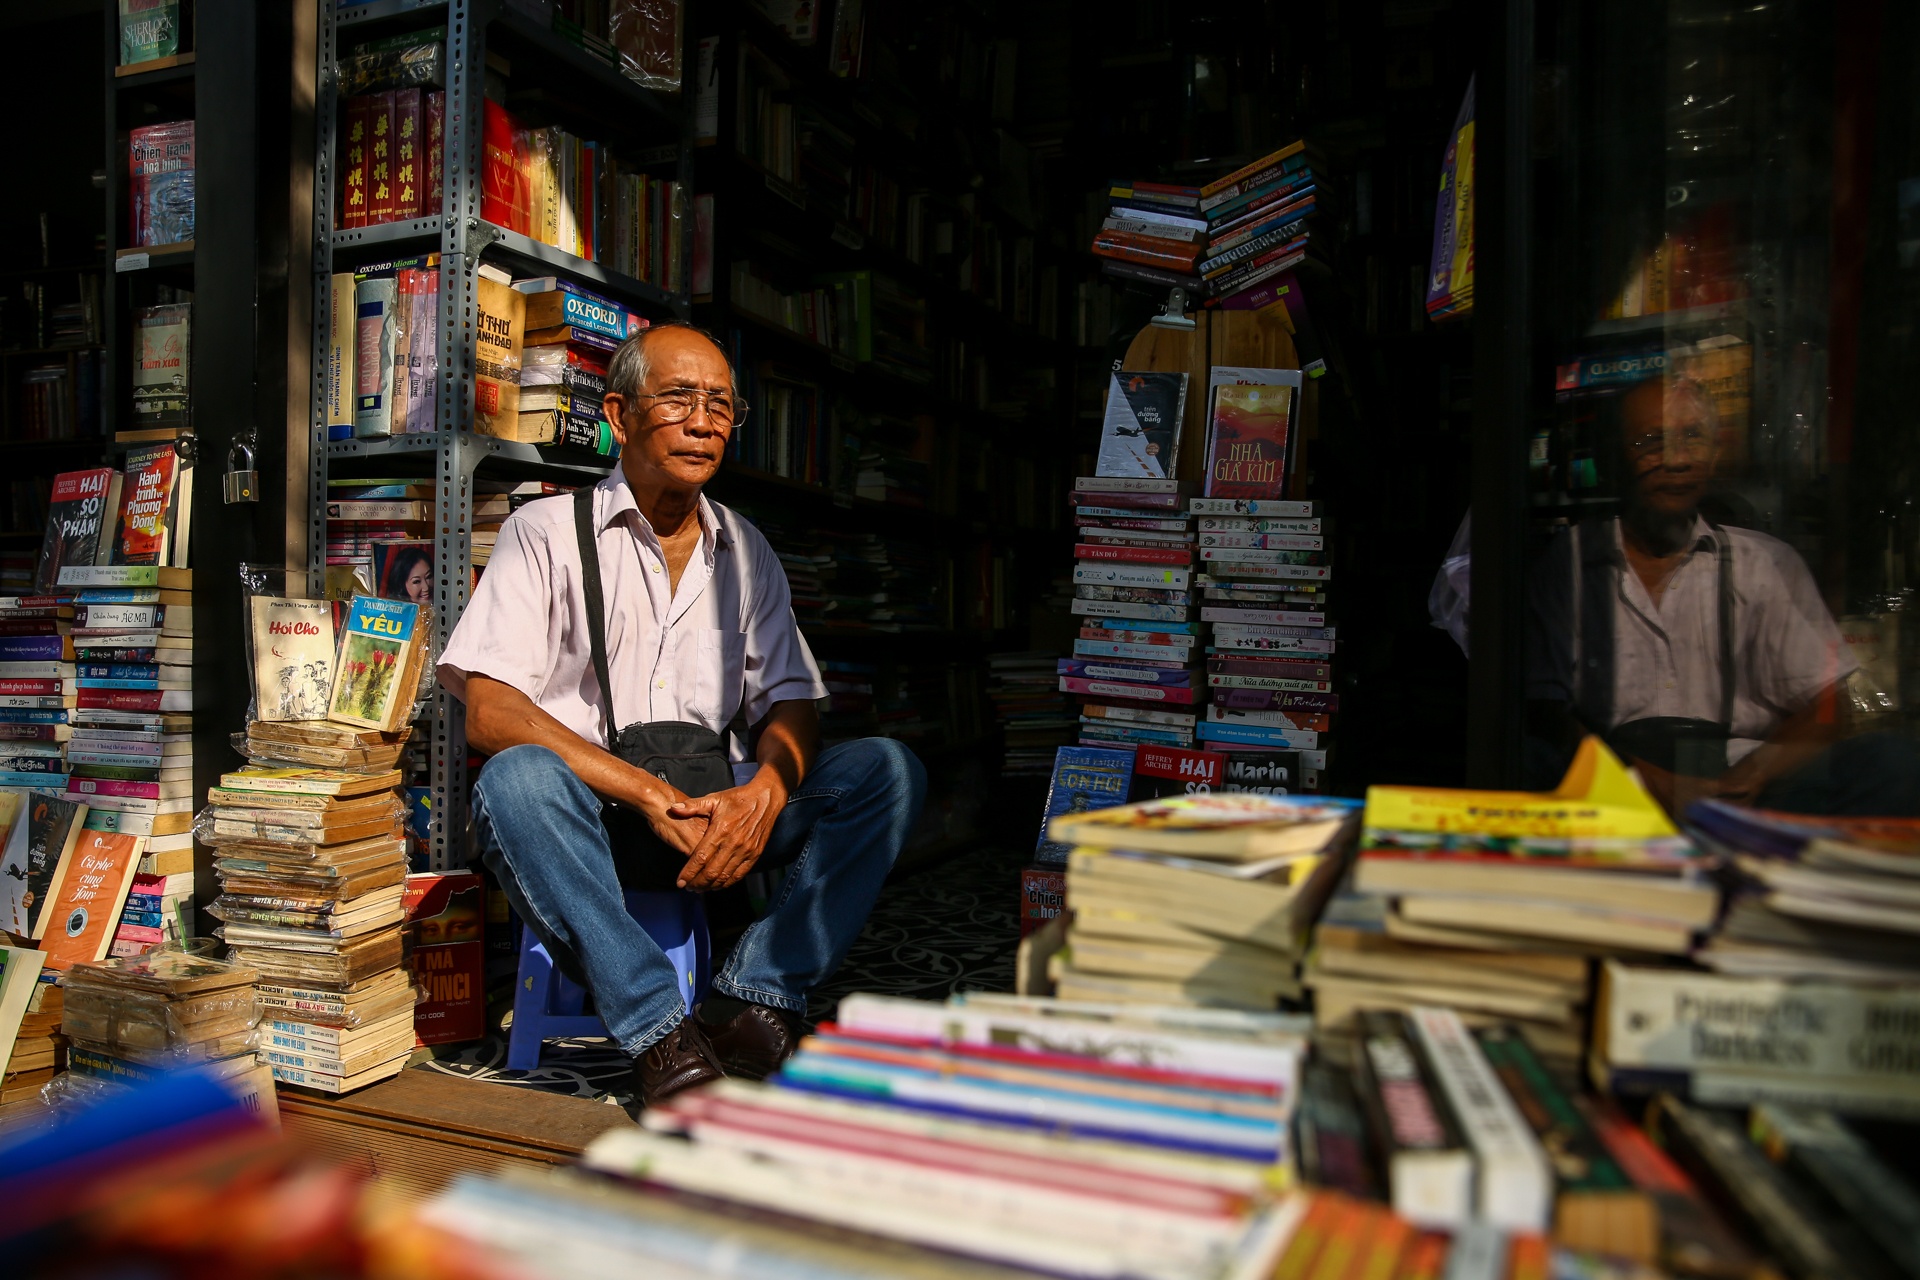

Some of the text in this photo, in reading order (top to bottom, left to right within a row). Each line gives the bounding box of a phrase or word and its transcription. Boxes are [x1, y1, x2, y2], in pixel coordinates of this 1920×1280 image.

[125, 16, 173, 40] SHERLOCK
[131, 32, 168, 48] HOLMES
[167, 142, 191, 157] tranh
[1263, 167, 1278, 179] QUEN
[1260, 192, 1278, 203] NHÂN
[1278, 184, 1292, 197] TÂM
[360, 258, 419, 274] OXFORD Idioms
[567, 299, 617, 325] OXFORD
[567, 314, 617, 336] Advanced Learner's
[162, 357, 180, 369] xưa
[575, 403, 596, 416] KAMUS
[582, 426, 596, 438] Việt
[1231, 442, 1263, 462] NHÀ
[138, 469, 161, 487] Hành
[1215, 459, 1277, 483] GIẢ KIM
[79, 474, 105, 494] HAI
[136, 485, 157, 502] trình
[79, 492, 101, 517] SỐ
[126, 499, 162, 518] Phương
[61, 513, 97, 540] PHẬN
[131, 513, 156, 531] Đông
[363, 600, 404, 615] DANIELLE STEEL
[359, 613, 403, 635] YÊU
[1254, 636, 1280, 649] BOSS
[1179, 757, 1215, 779] HAI
[29, 848, 46, 860] đường
[31, 856, 46, 868] băng
[80, 855, 114, 872] Cà phê
[79, 873, 105, 889] cùng
[69, 885, 98, 903] Tony
[1028, 889, 1064, 906] Chiến
[425, 949, 455, 971] MÃ
[422, 971, 471, 1003] VINCI
